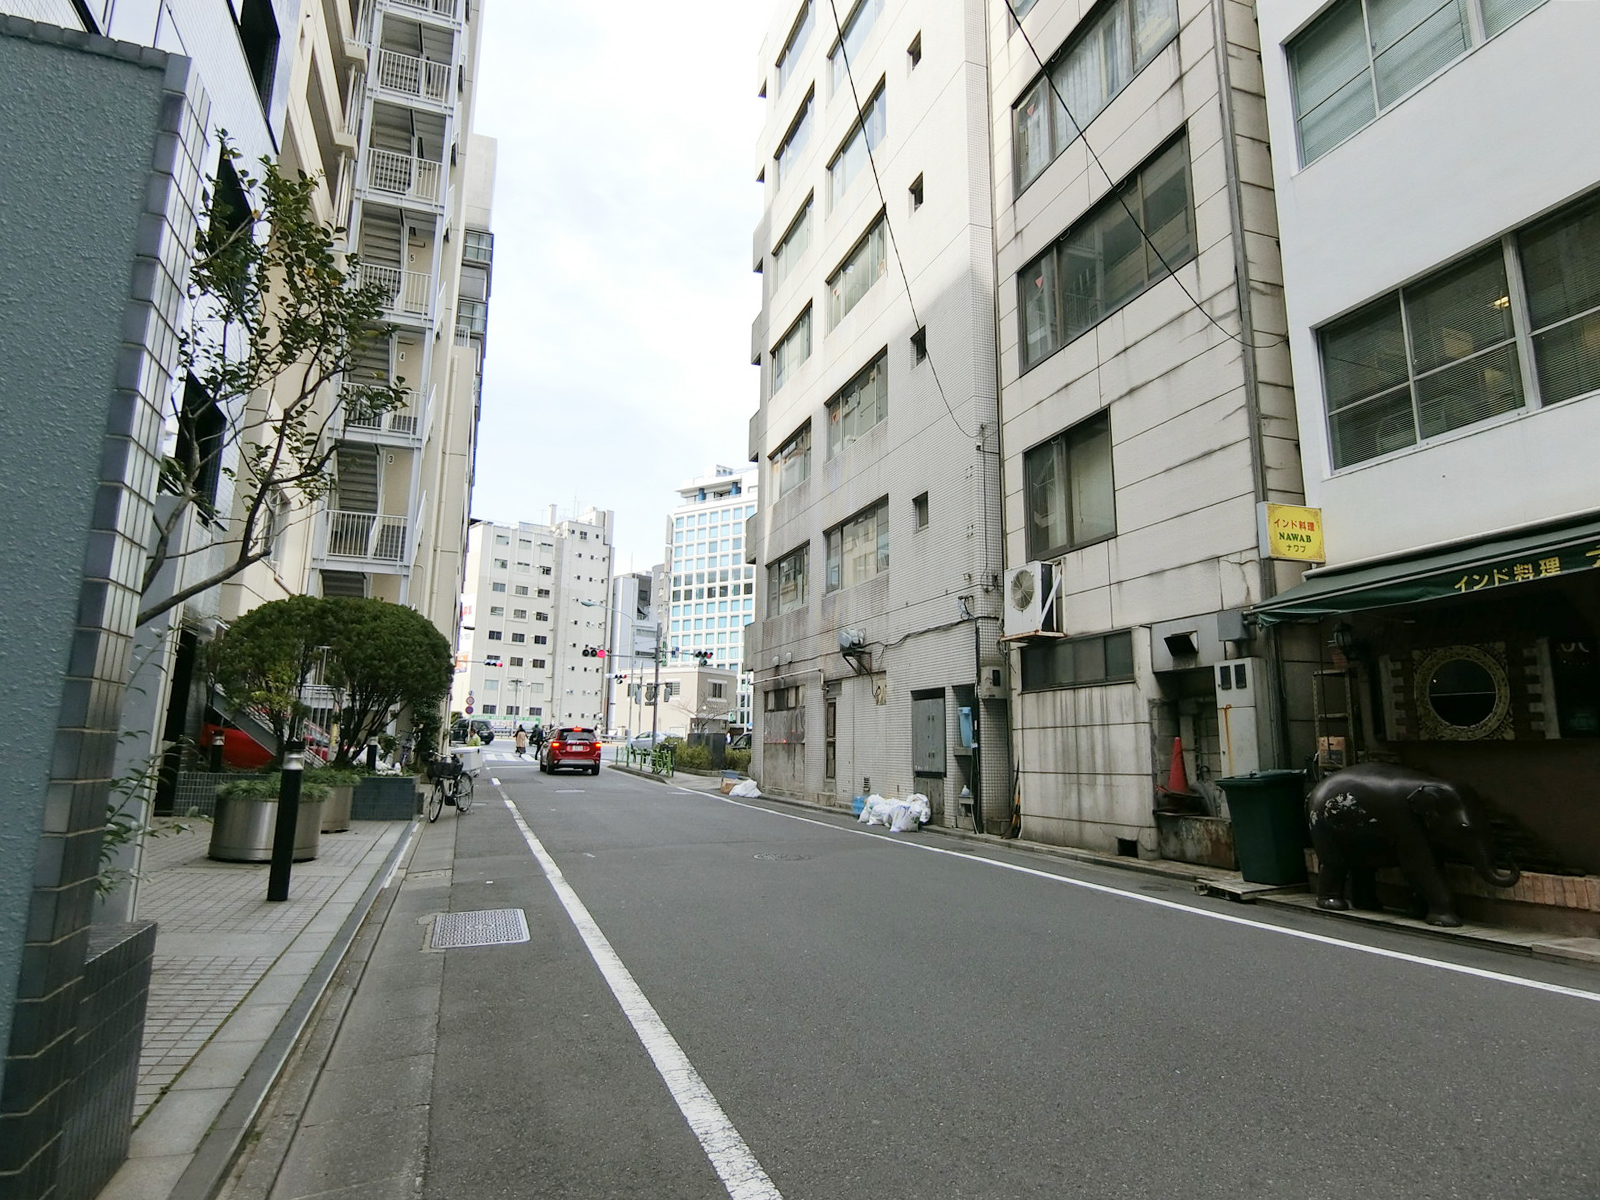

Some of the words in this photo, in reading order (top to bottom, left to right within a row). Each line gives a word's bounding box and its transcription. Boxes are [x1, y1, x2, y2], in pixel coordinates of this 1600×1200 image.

[1274, 518, 1315, 532] インド料理
[1278, 532, 1312, 543] NAWAB
[1454, 556, 1562, 593] インド料理
